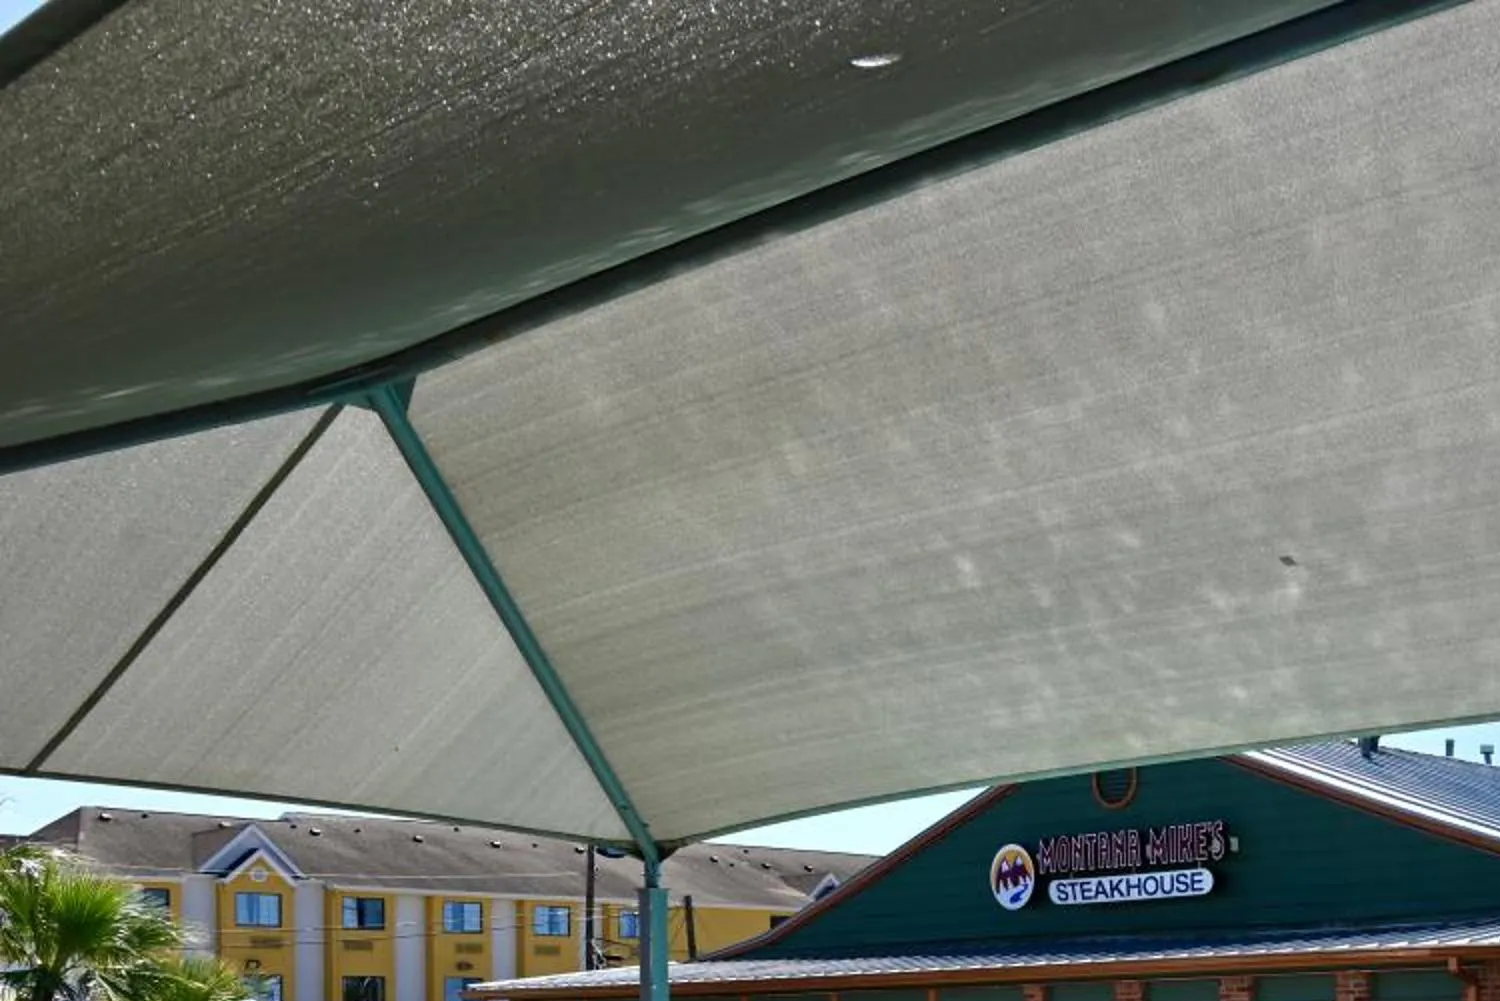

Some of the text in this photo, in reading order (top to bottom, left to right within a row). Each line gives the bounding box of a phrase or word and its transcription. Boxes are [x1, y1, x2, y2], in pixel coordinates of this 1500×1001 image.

[1037, 819, 1226, 875] MONTANA MIKE'S
[1055, 871, 1205, 901] STEAKHOUSE
